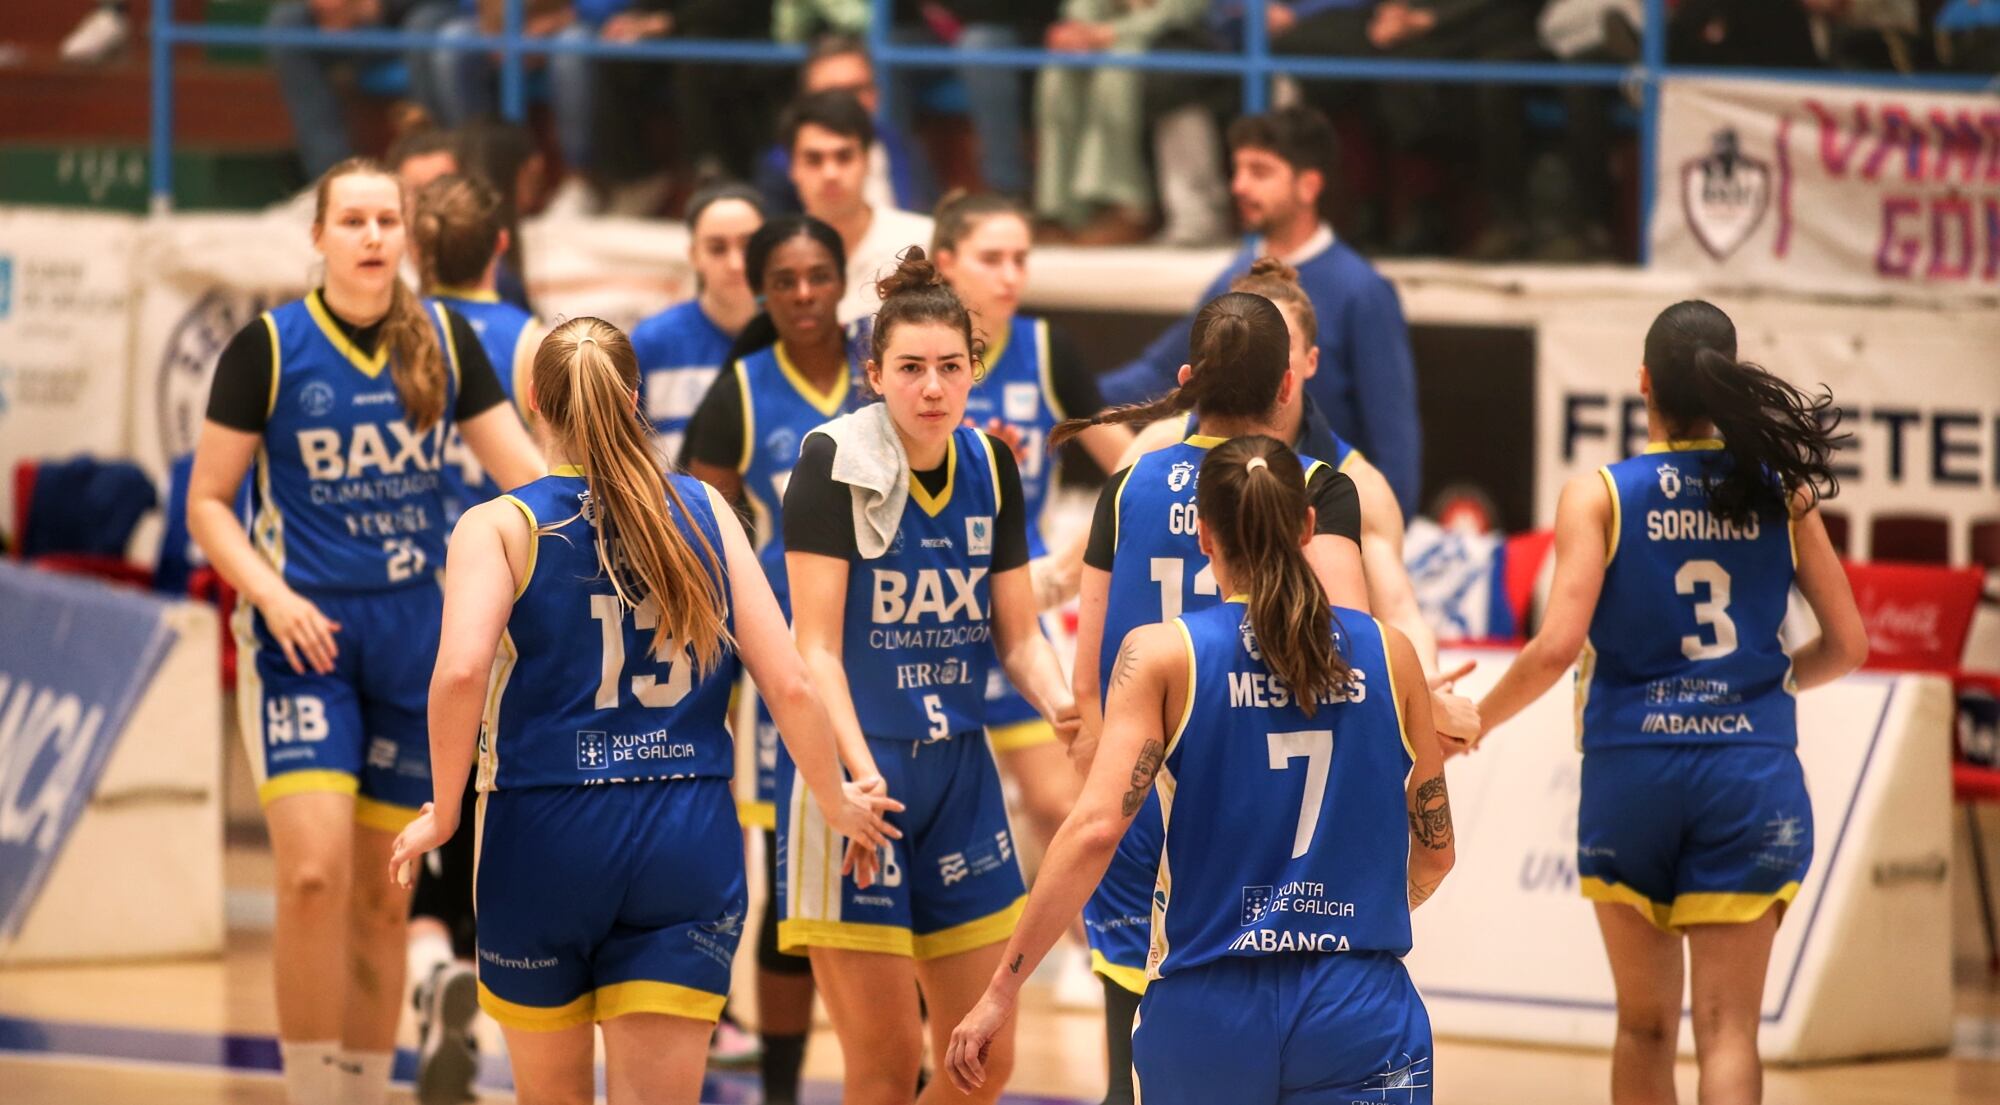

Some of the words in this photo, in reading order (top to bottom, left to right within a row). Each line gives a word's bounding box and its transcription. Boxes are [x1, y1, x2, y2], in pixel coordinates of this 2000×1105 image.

[871, 567, 991, 625] BAX
[1674, 559, 1738, 661] 3
[590, 594, 693, 711] 13
[611, 728, 667, 750] XUNTA
[922, 694, 950, 741] 5
[612, 749, 634, 762] DE
[637, 742, 695, 761] GALICIA
[1266, 730, 1333, 860] 7
[1271, 898, 1289, 913] DE
[1293, 898, 1355, 917] GALICIA
[1275, 881, 1325, 899] XUNTA
